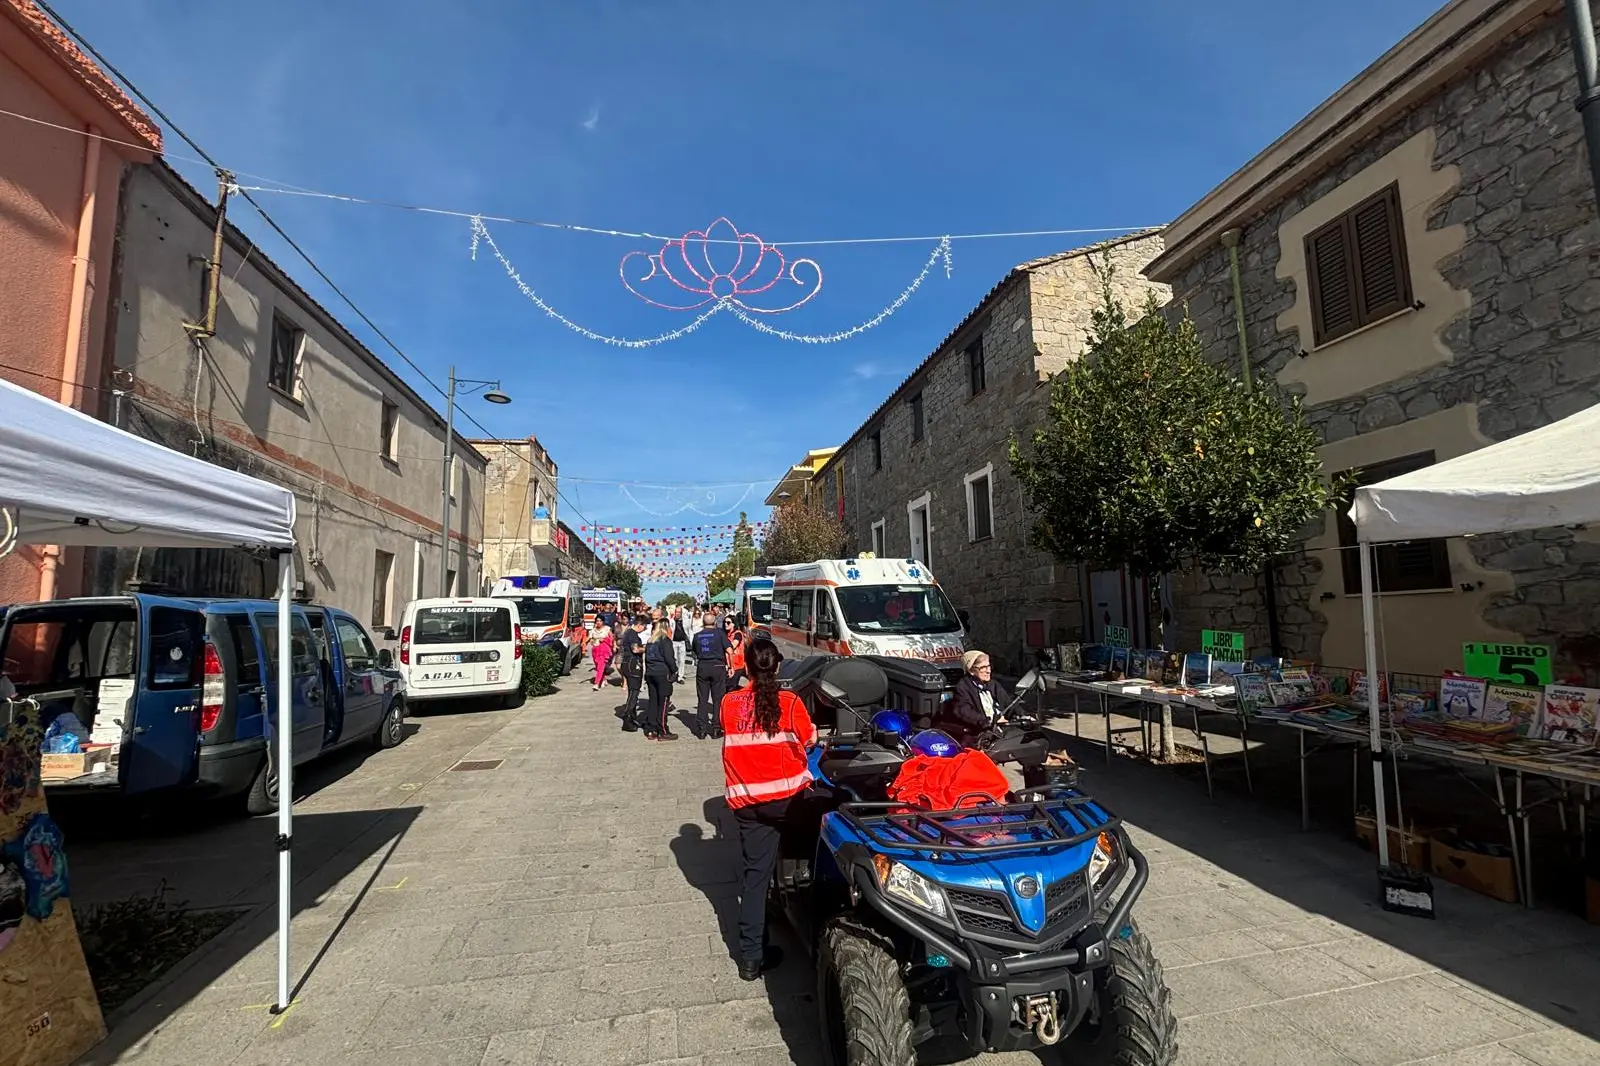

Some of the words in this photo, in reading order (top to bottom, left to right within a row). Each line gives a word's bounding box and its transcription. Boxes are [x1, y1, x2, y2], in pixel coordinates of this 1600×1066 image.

[1105, 626, 1128, 641] LIBRI
[1212, 632, 1233, 647] LIBRI
[1203, 646, 1243, 662] SCONTATI
[1465, 644, 1474, 654] 1
[1482, 645, 1548, 657] LIBRO
[1499, 656, 1539, 685] 5
[1494, 688, 1536, 699] Mandala
